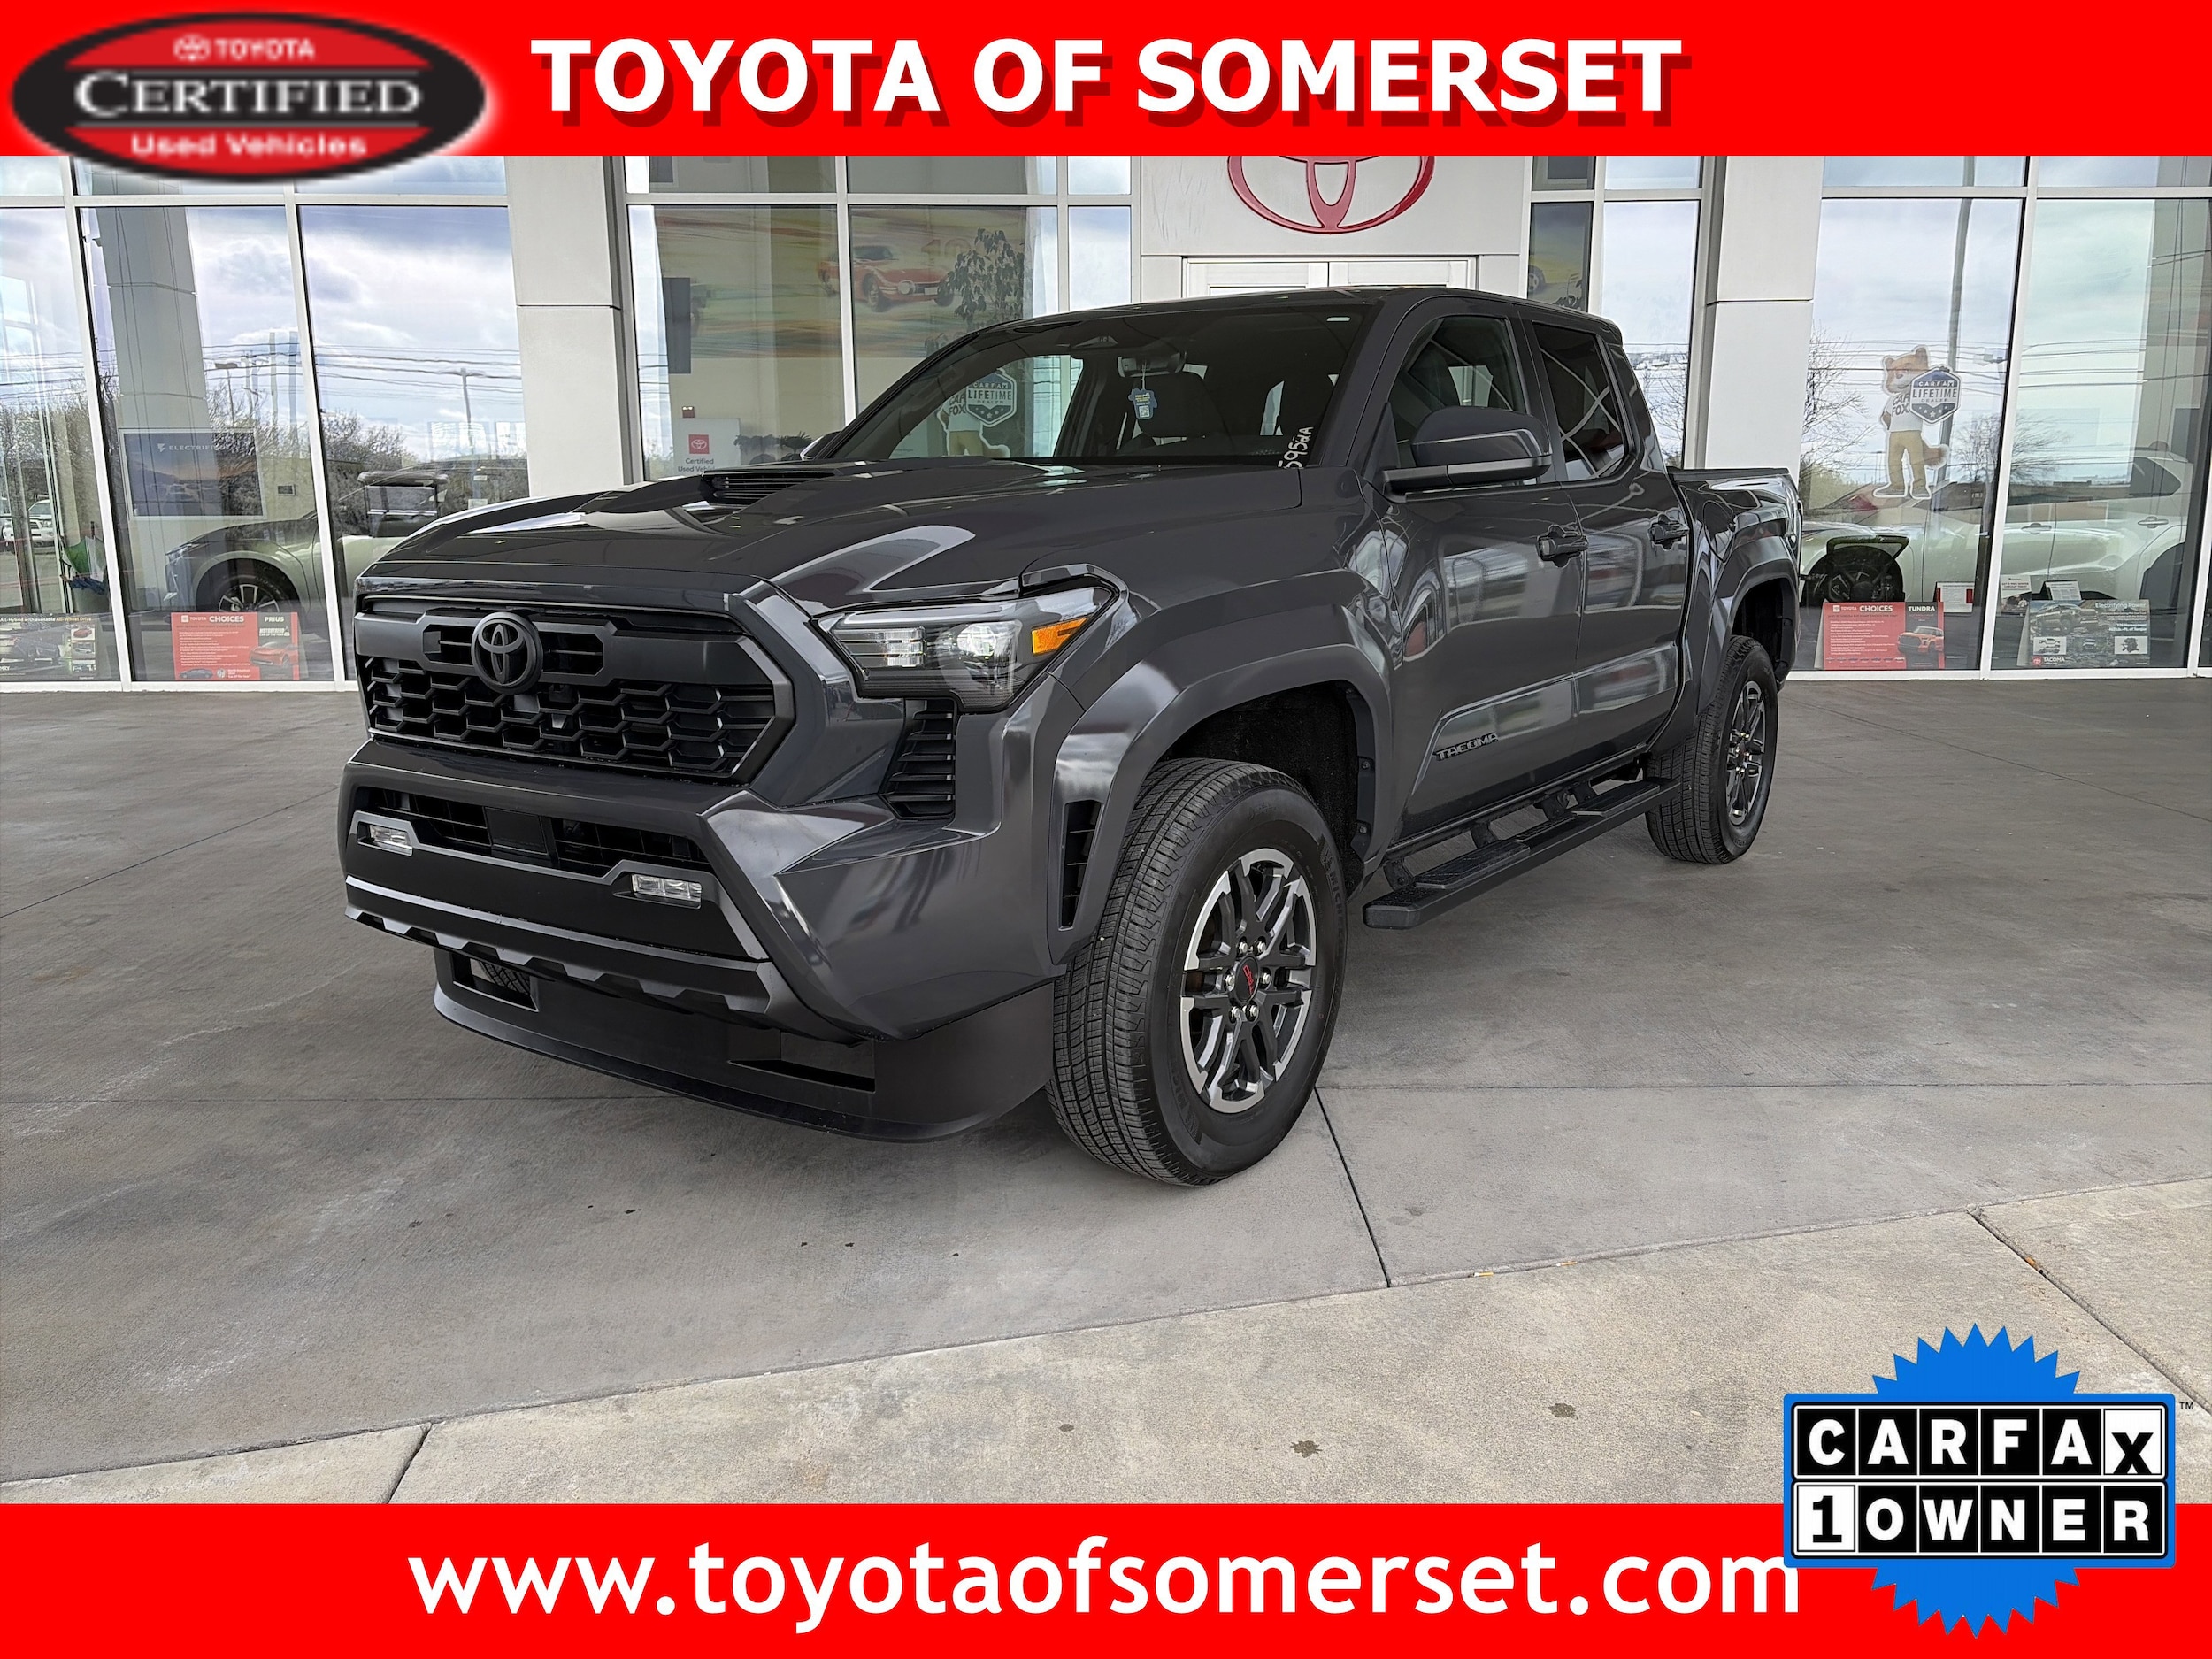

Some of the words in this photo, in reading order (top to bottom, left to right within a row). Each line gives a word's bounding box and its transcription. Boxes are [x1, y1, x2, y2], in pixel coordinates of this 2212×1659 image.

[968, 389, 1012, 400] LIFETIME
[1912, 388, 1957, 398] LIFETIME
[949, 405, 966, 416] FOX
[1892, 403, 1909, 417] FOX
[1432, 732, 1499, 761] TACOMA
